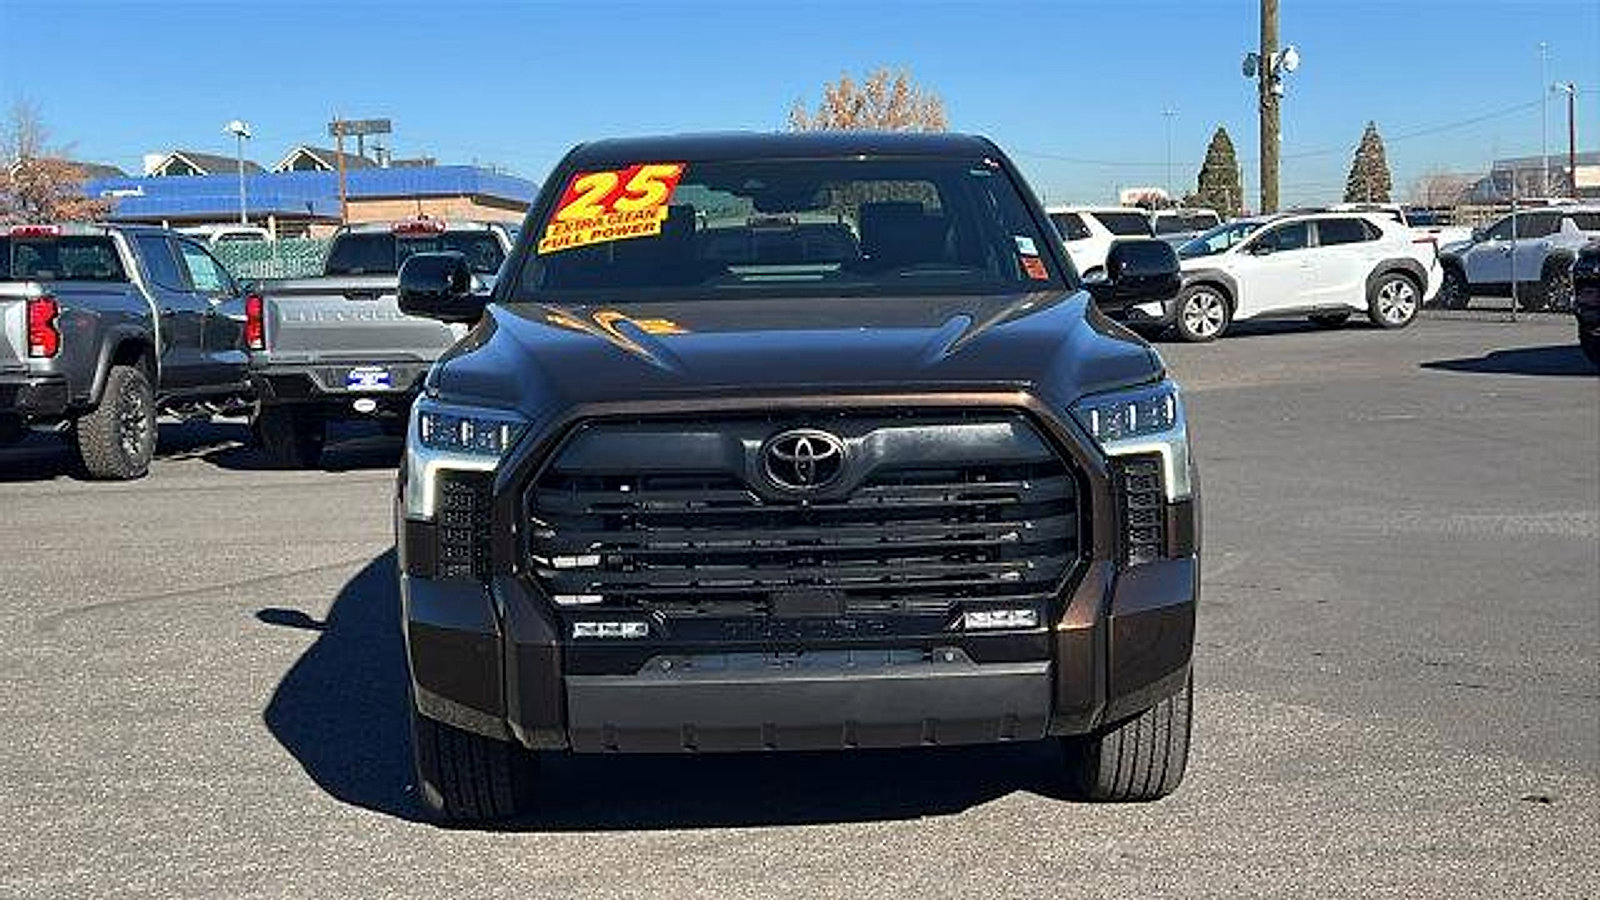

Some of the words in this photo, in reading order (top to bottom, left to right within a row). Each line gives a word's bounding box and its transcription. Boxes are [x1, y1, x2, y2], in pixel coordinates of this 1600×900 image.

[558, 164, 680, 221] 25
[541, 232, 582, 250] FULL
[590, 221, 656, 241] POWER
[554, 217, 603, 236] EXTRA
[607, 208, 657, 225] CLEAN
